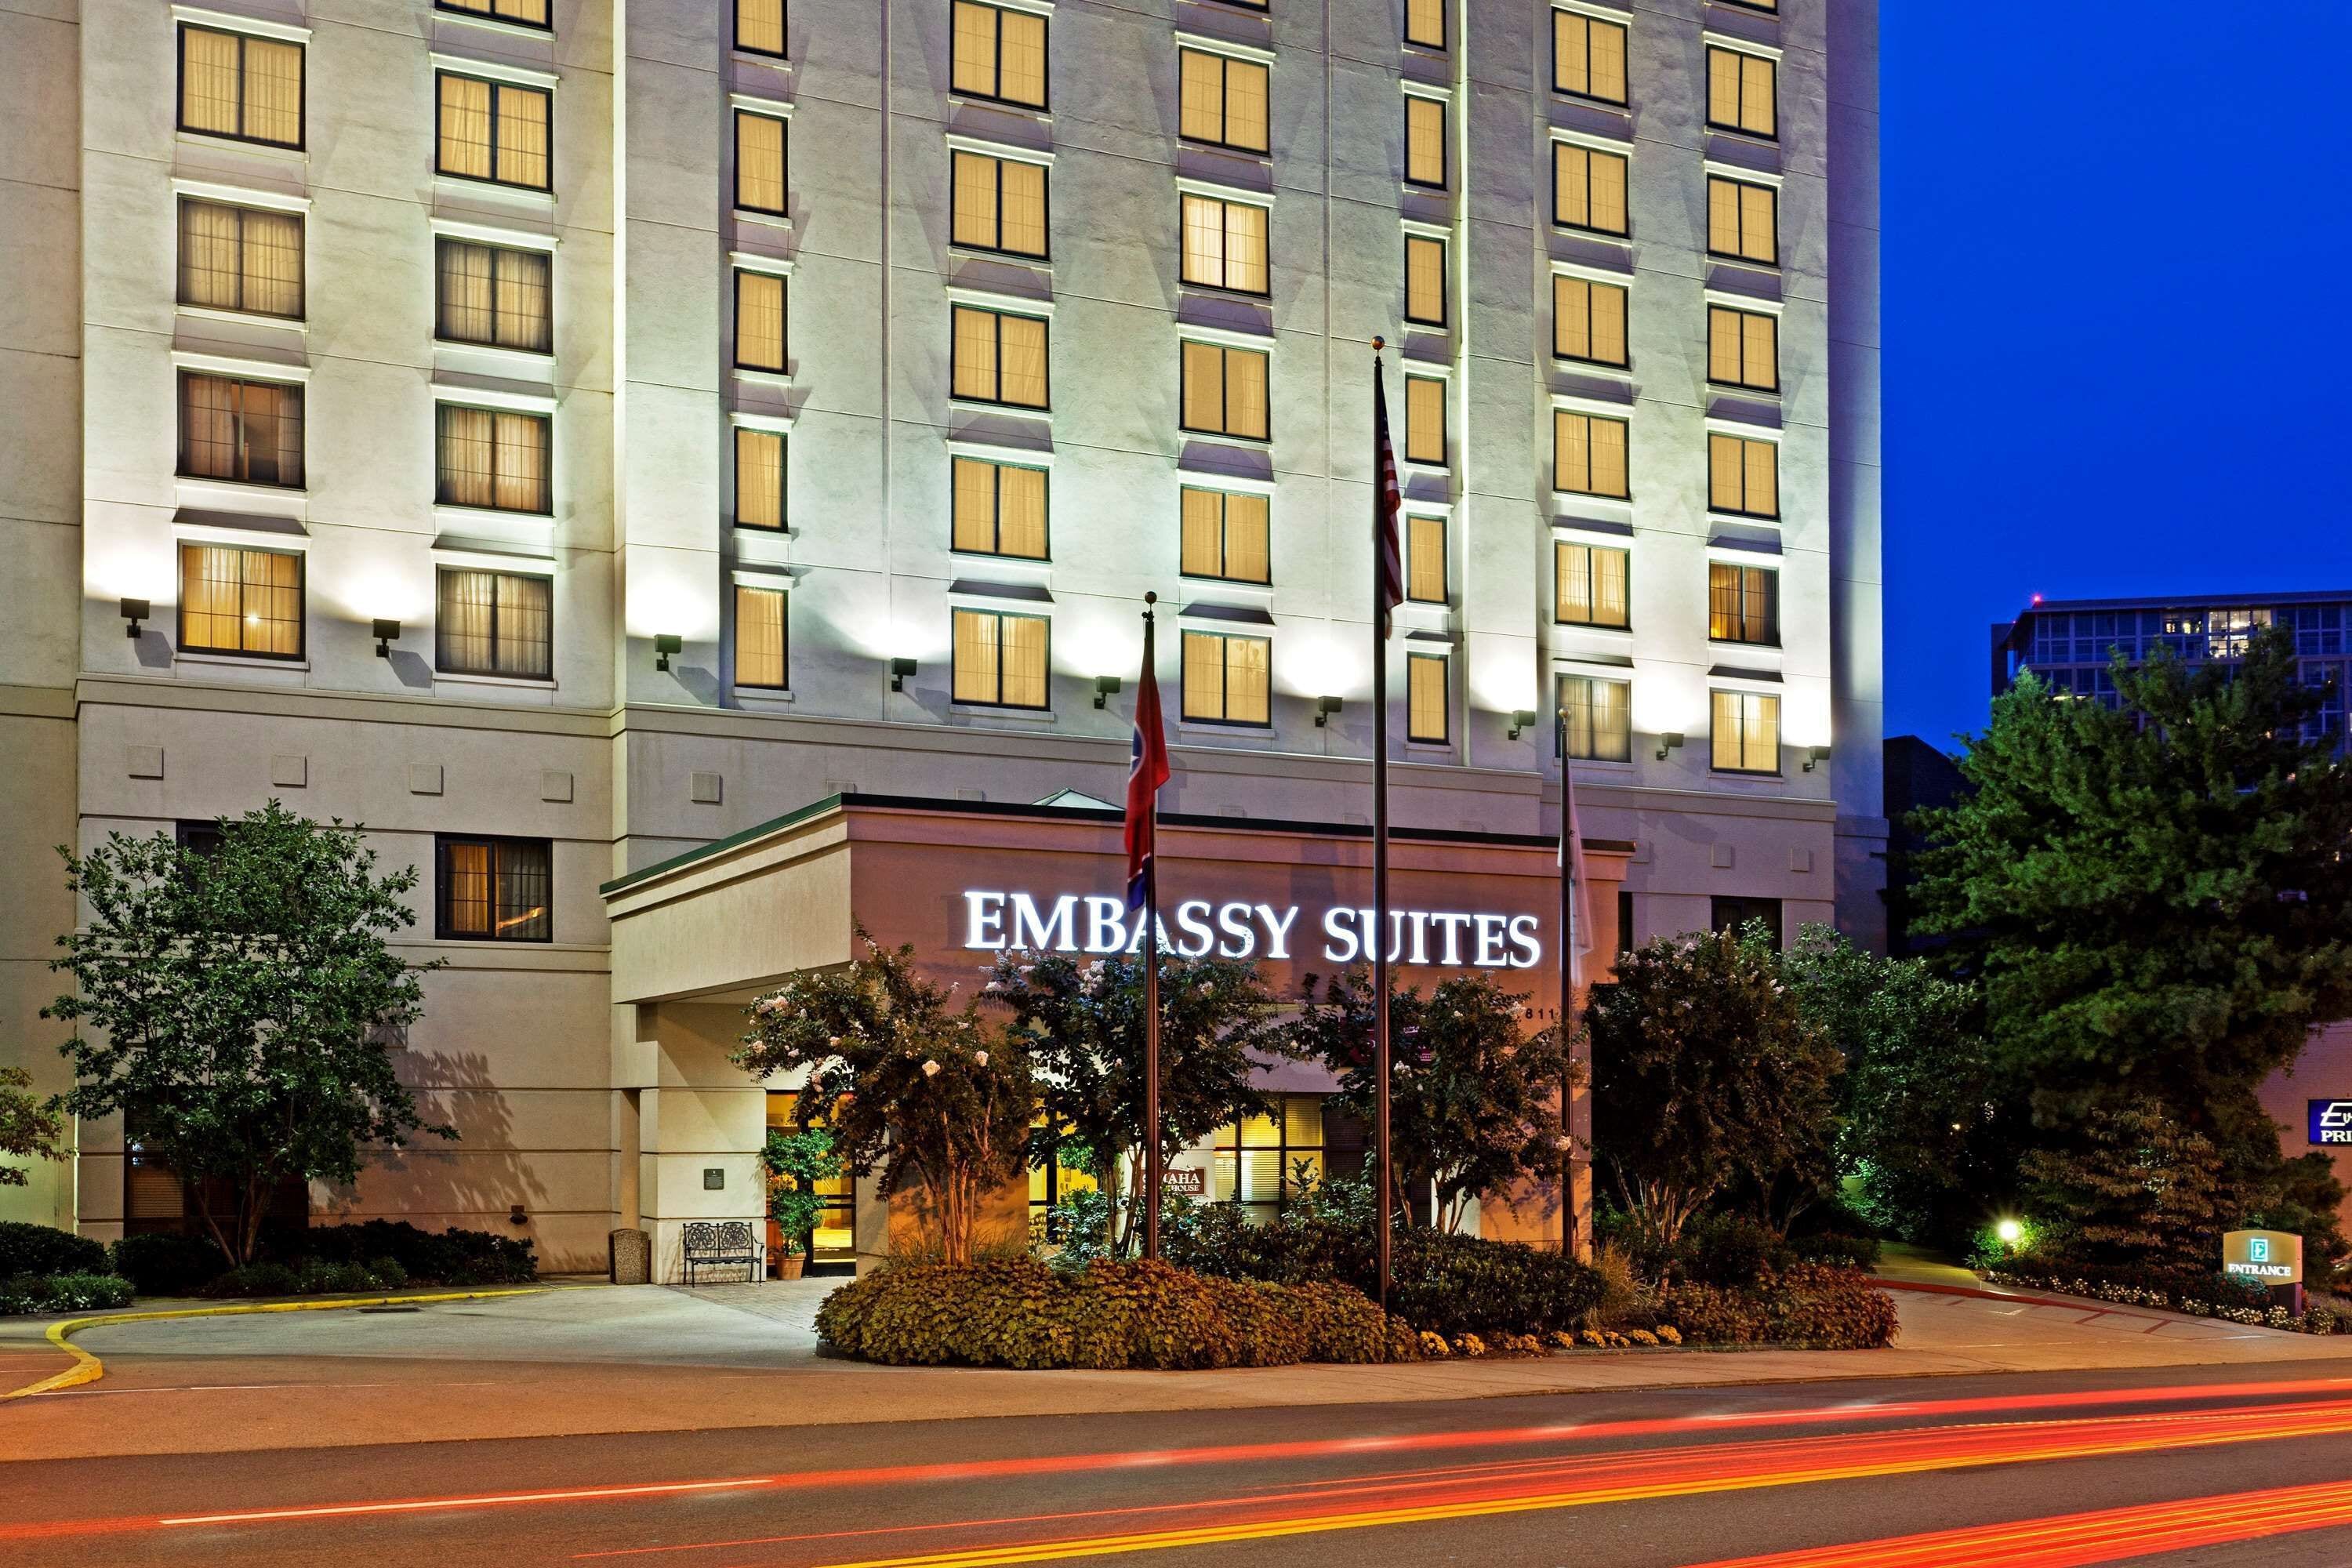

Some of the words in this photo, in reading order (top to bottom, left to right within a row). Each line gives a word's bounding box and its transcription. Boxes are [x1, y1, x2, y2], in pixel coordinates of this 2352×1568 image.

[964, 891, 1298, 958] EMBASSY
[1324, 907, 1541, 968] SUITES
[2227, 1263, 2292, 1277] ENTRANCE
